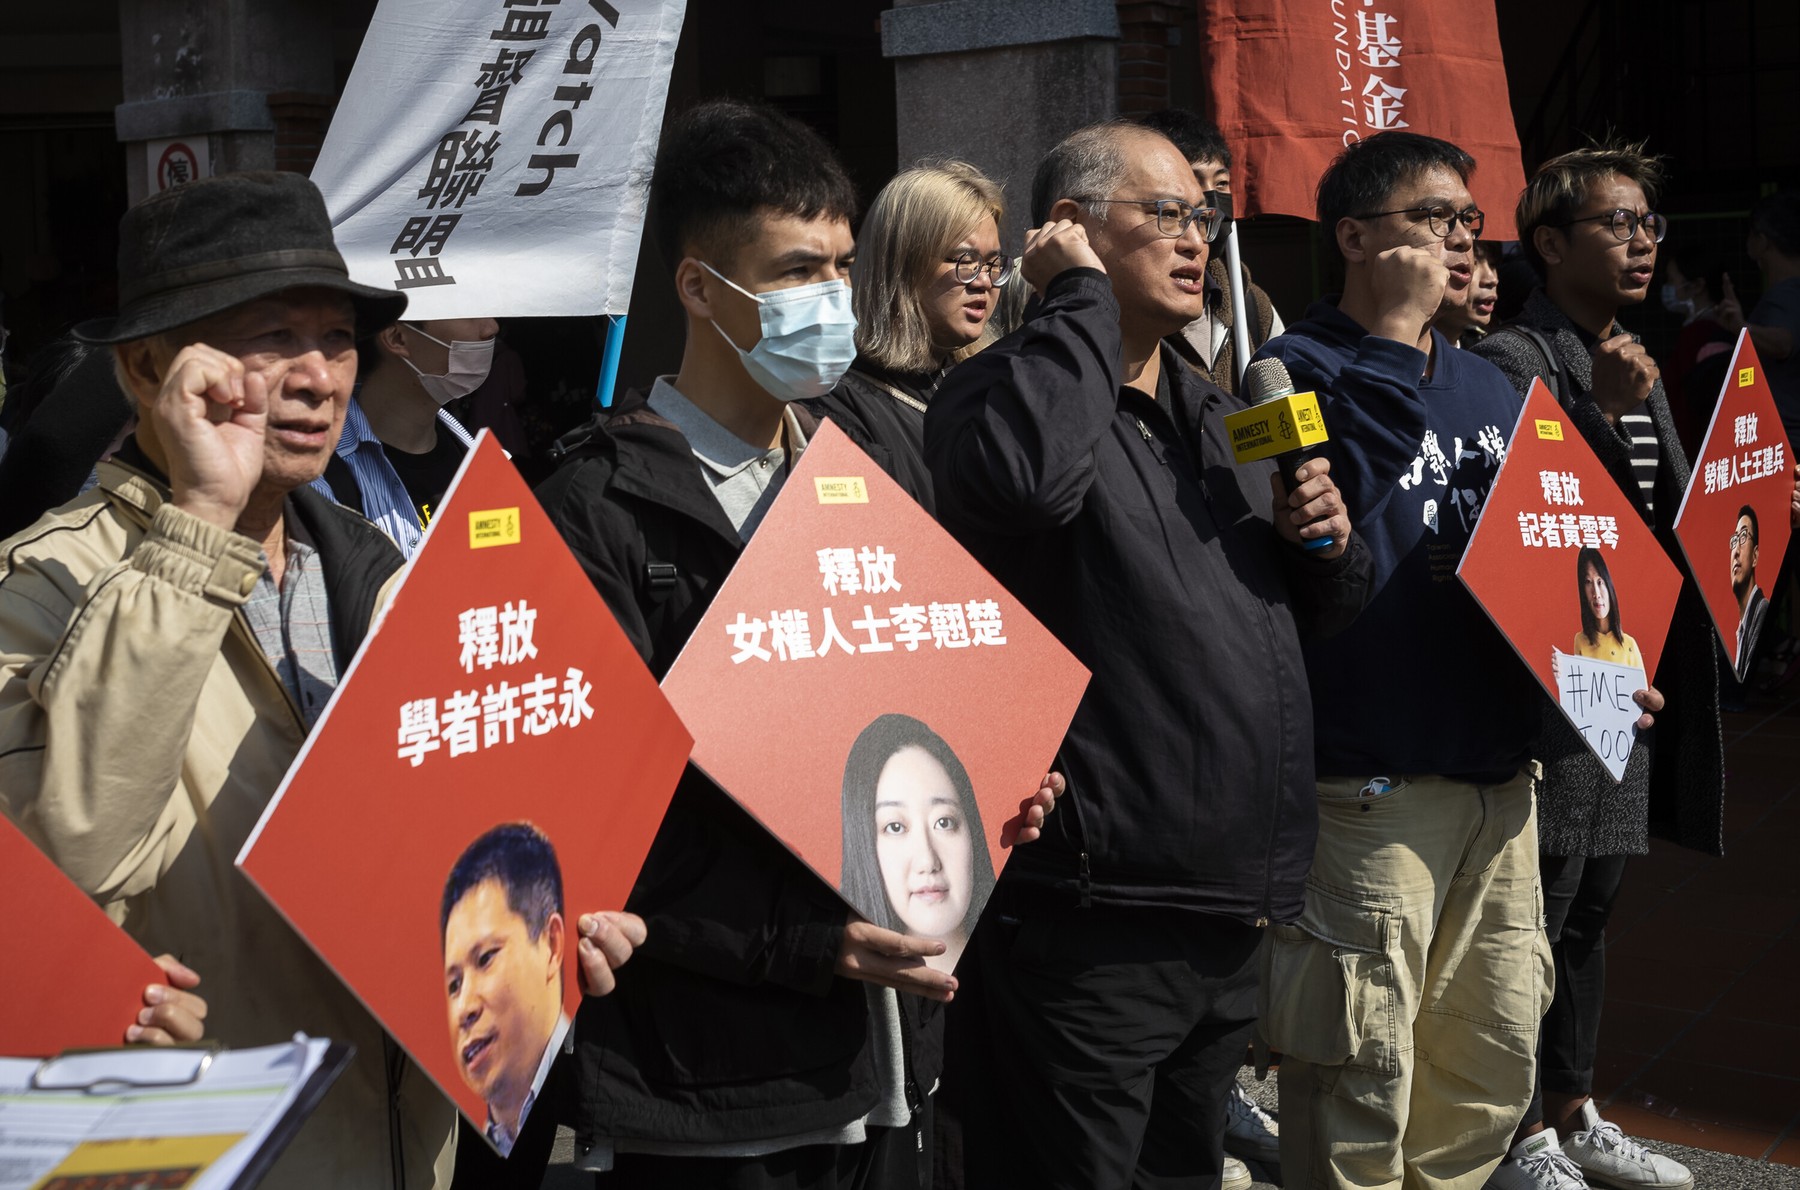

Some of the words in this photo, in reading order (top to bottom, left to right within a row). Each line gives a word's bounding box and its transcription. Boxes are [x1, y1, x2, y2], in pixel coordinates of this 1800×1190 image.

[514, 0, 620, 196] atch
[1232, 419, 1270, 442] AMNESTY
[1236, 435, 1275, 452] INTERNATIONAL
[1734, 412, 1758, 448] 釋放
[1539, 470, 1584, 506] 釋放
[1704, 442, 1784, 495] 勞權人士王建兵
[1517, 510, 1619, 550] 記者黃雪琴
[816, 546, 902, 596] 釋放
[458, 599, 538, 674] 釋放
[726, 598, 1007, 664] 女權人士李翹楚
[398, 667, 595, 767] 學者許志永
[1566, 665, 1630, 718] #ME
